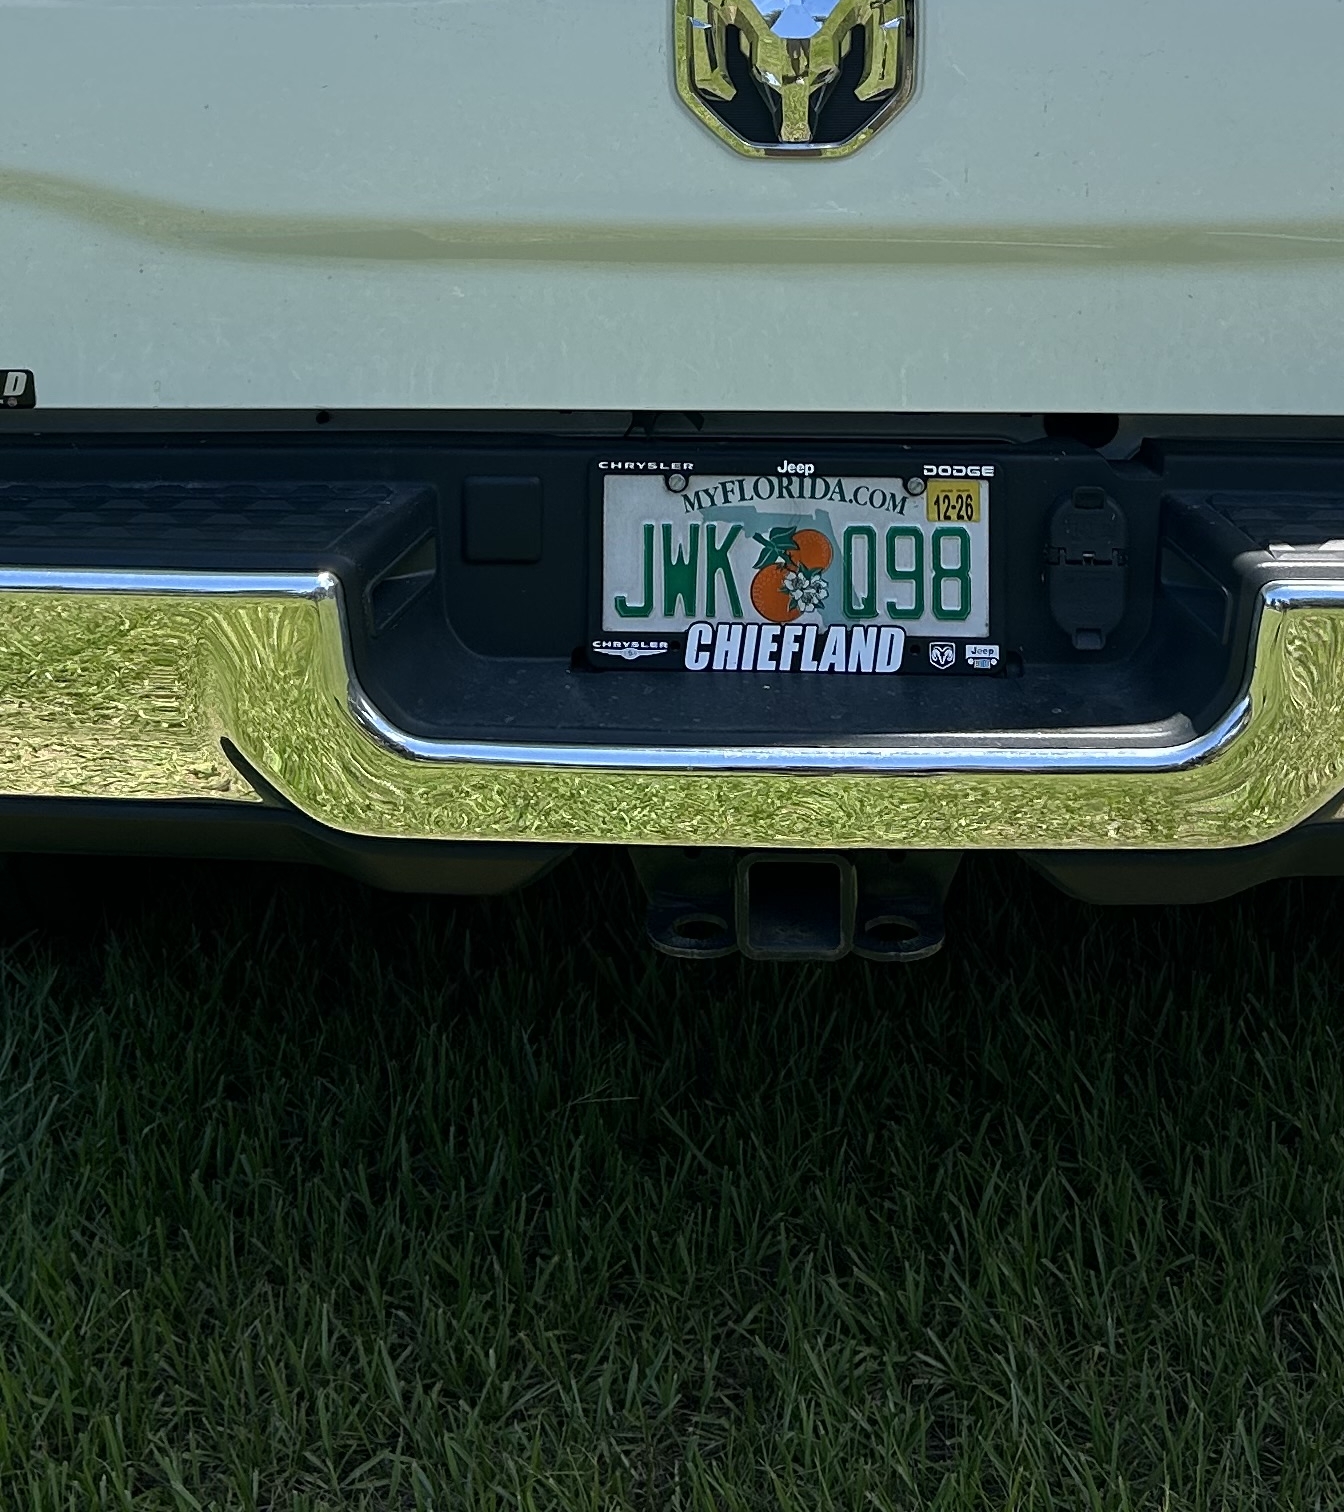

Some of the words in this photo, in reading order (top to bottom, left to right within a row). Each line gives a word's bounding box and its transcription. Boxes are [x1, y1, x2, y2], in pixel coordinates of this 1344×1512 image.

[598, 461, 694, 471] CHRYSLER
[777, 460, 815, 476] Jeep
[923, 464, 995, 477] DODGE
[933, 493, 974, 522] 12-26
[614, 523, 745, 619] JWK
[841, 524, 972, 622] Q98
[592, 640, 669, 649] CHRYSLER
[685, 622, 905, 673] CHIEFLAND
[970, 646, 995, 657] Jeep
